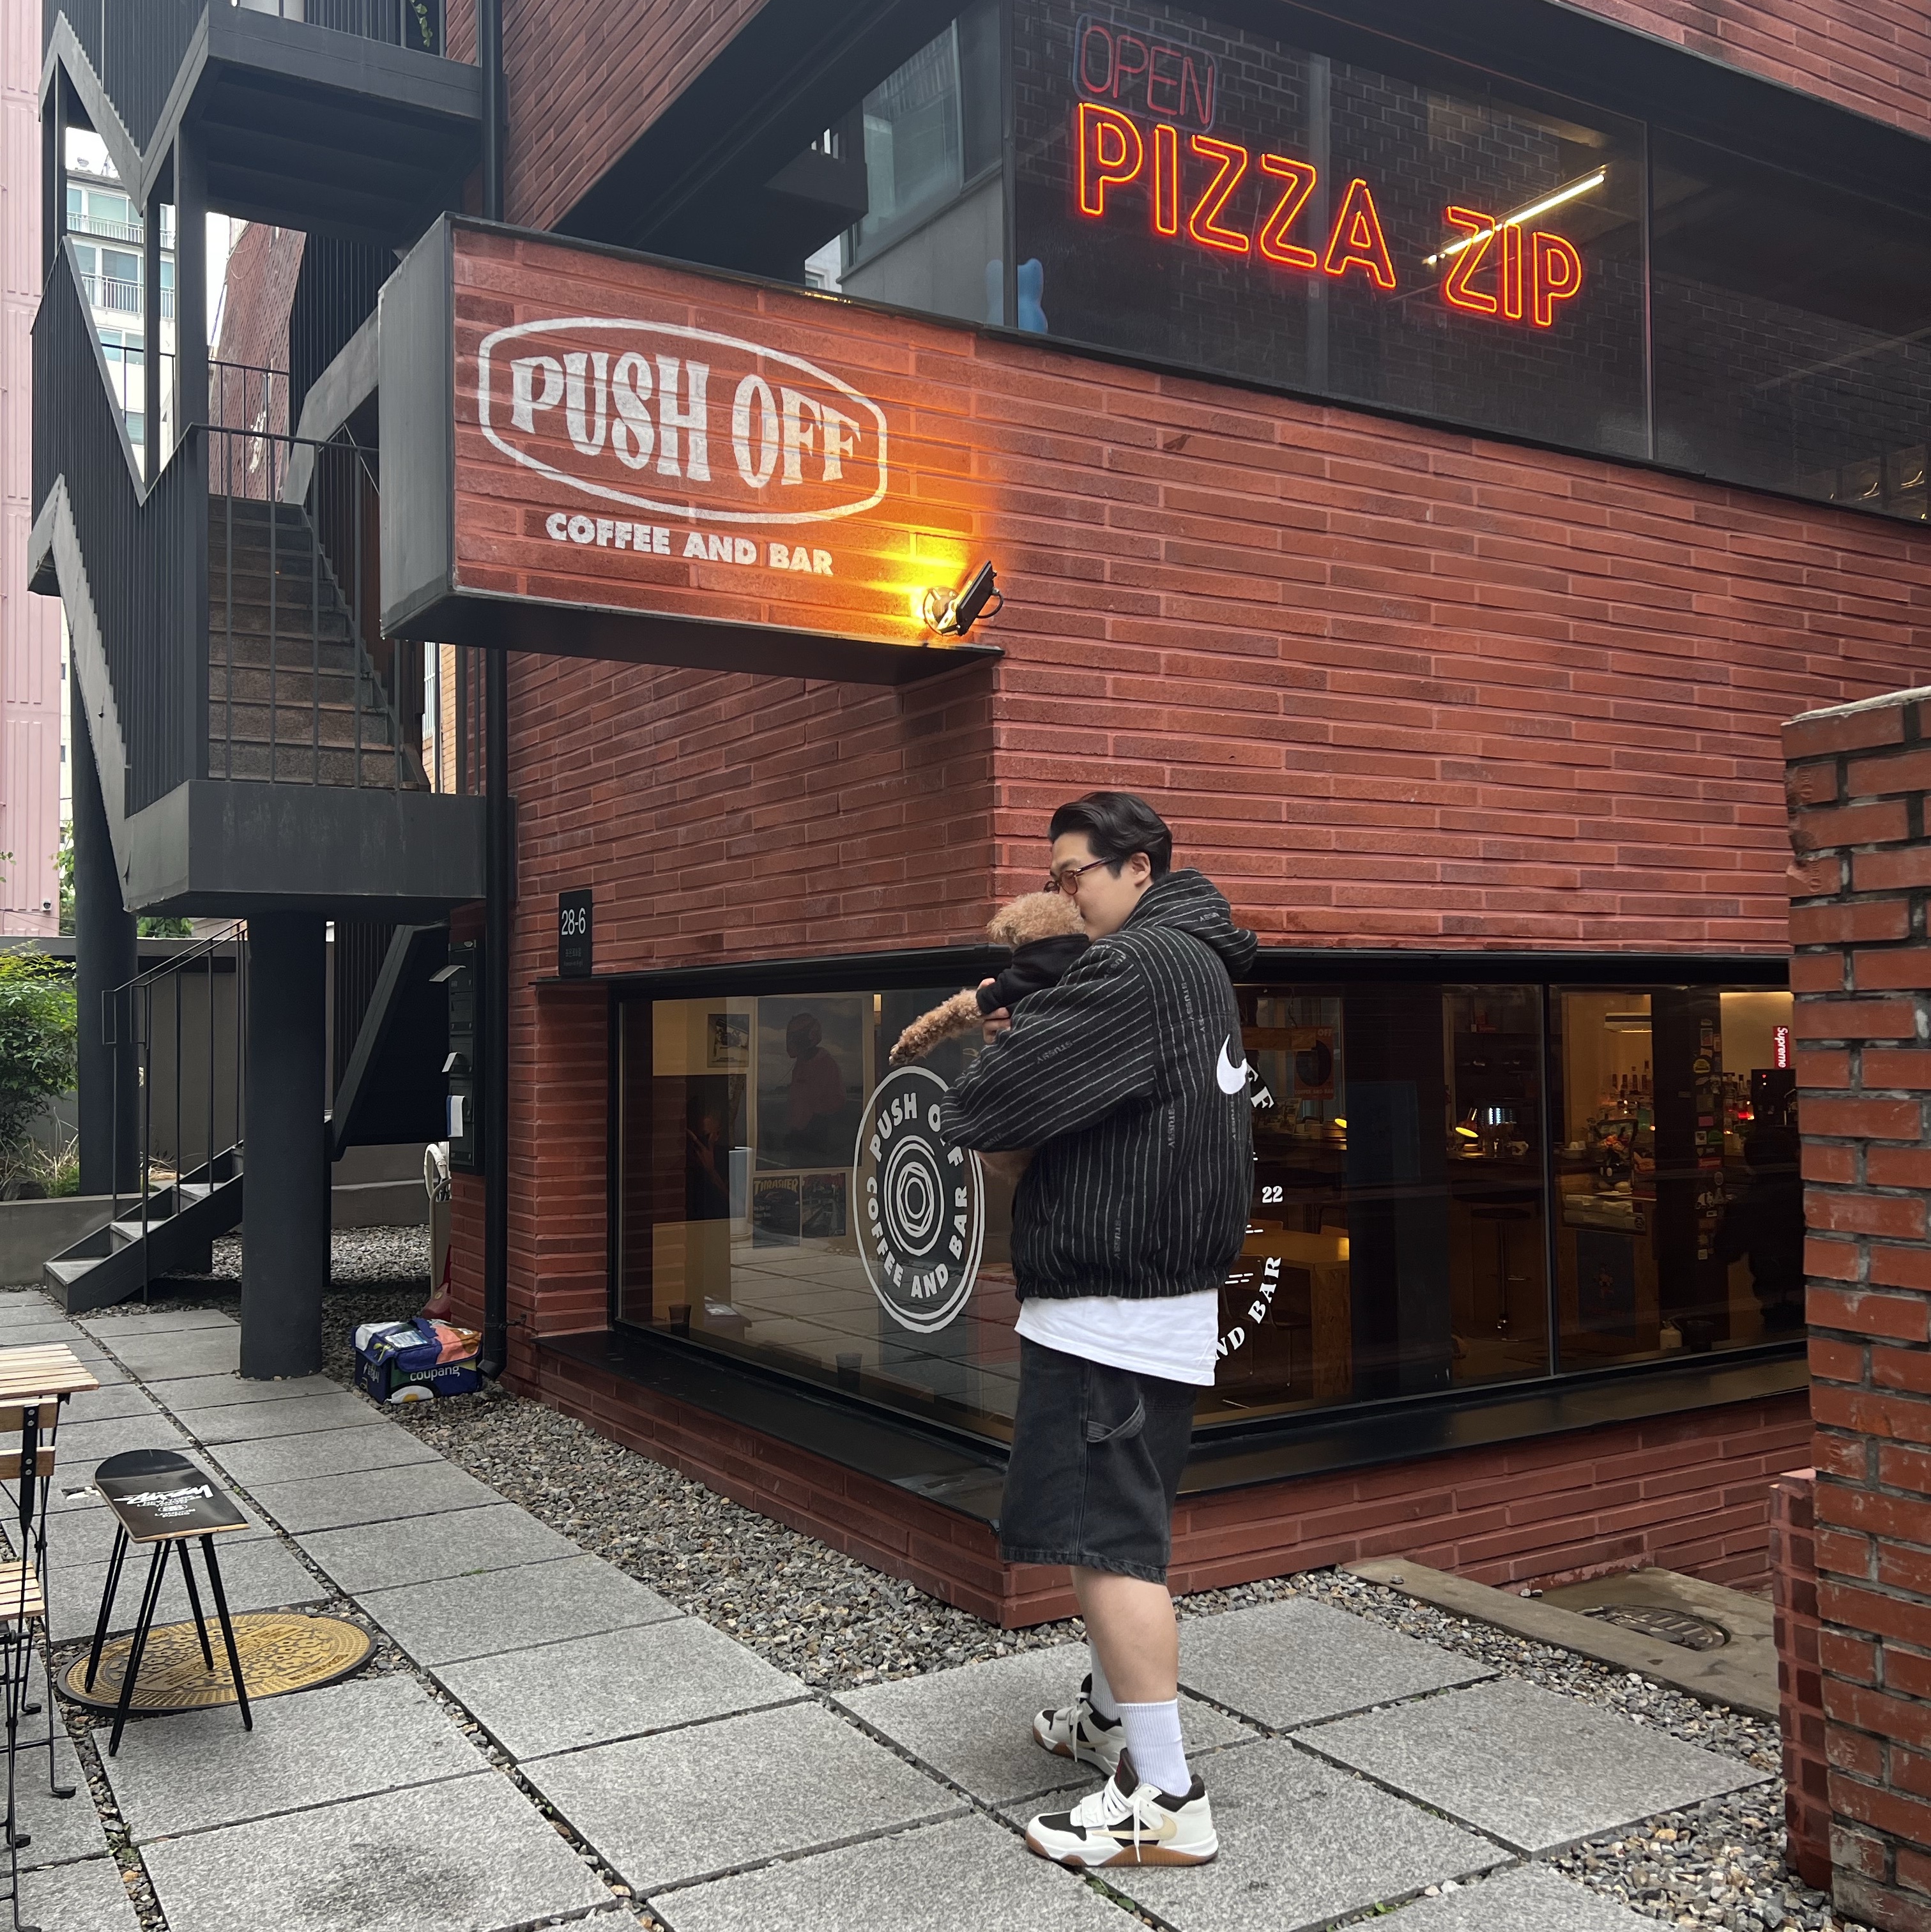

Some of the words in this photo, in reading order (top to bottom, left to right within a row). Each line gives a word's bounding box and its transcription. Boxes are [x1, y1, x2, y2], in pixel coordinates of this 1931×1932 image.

[1080, 25, 1215, 125] OPEN
[1078, 101, 1396, 290] PIZZA
[1445, 204, 1582, 328] ZIP
[510, 351, 711, 482] PUSH
[731, 374, 862, 488] OFF
[546, 512, 671, 555] COFFEE
[683, 532, 757, 565] AND
[768, 542, 834, 575] BAR
[561, 907, 586, 936] 28-6
[1037, 1040, 1073, 1065] STUSSY
[1774, 1027, 1788, 1068] Supreme
[869, 1092, 917, 1162] PUSH
[754, 1178, 799, 1196] THRASHER
[1262, 1185, 1283, 1203] 22
[867, 1176, 904, 1288] COFFEE
[910, 1263, 949, 1298] AND
[949, 1185, 968, 1260] BAR
[1216, 1327, 1245, 1361] ND
[1248, 1256, 1281, 1324] BAR
[409, 1365, 461, 1381] coupang
